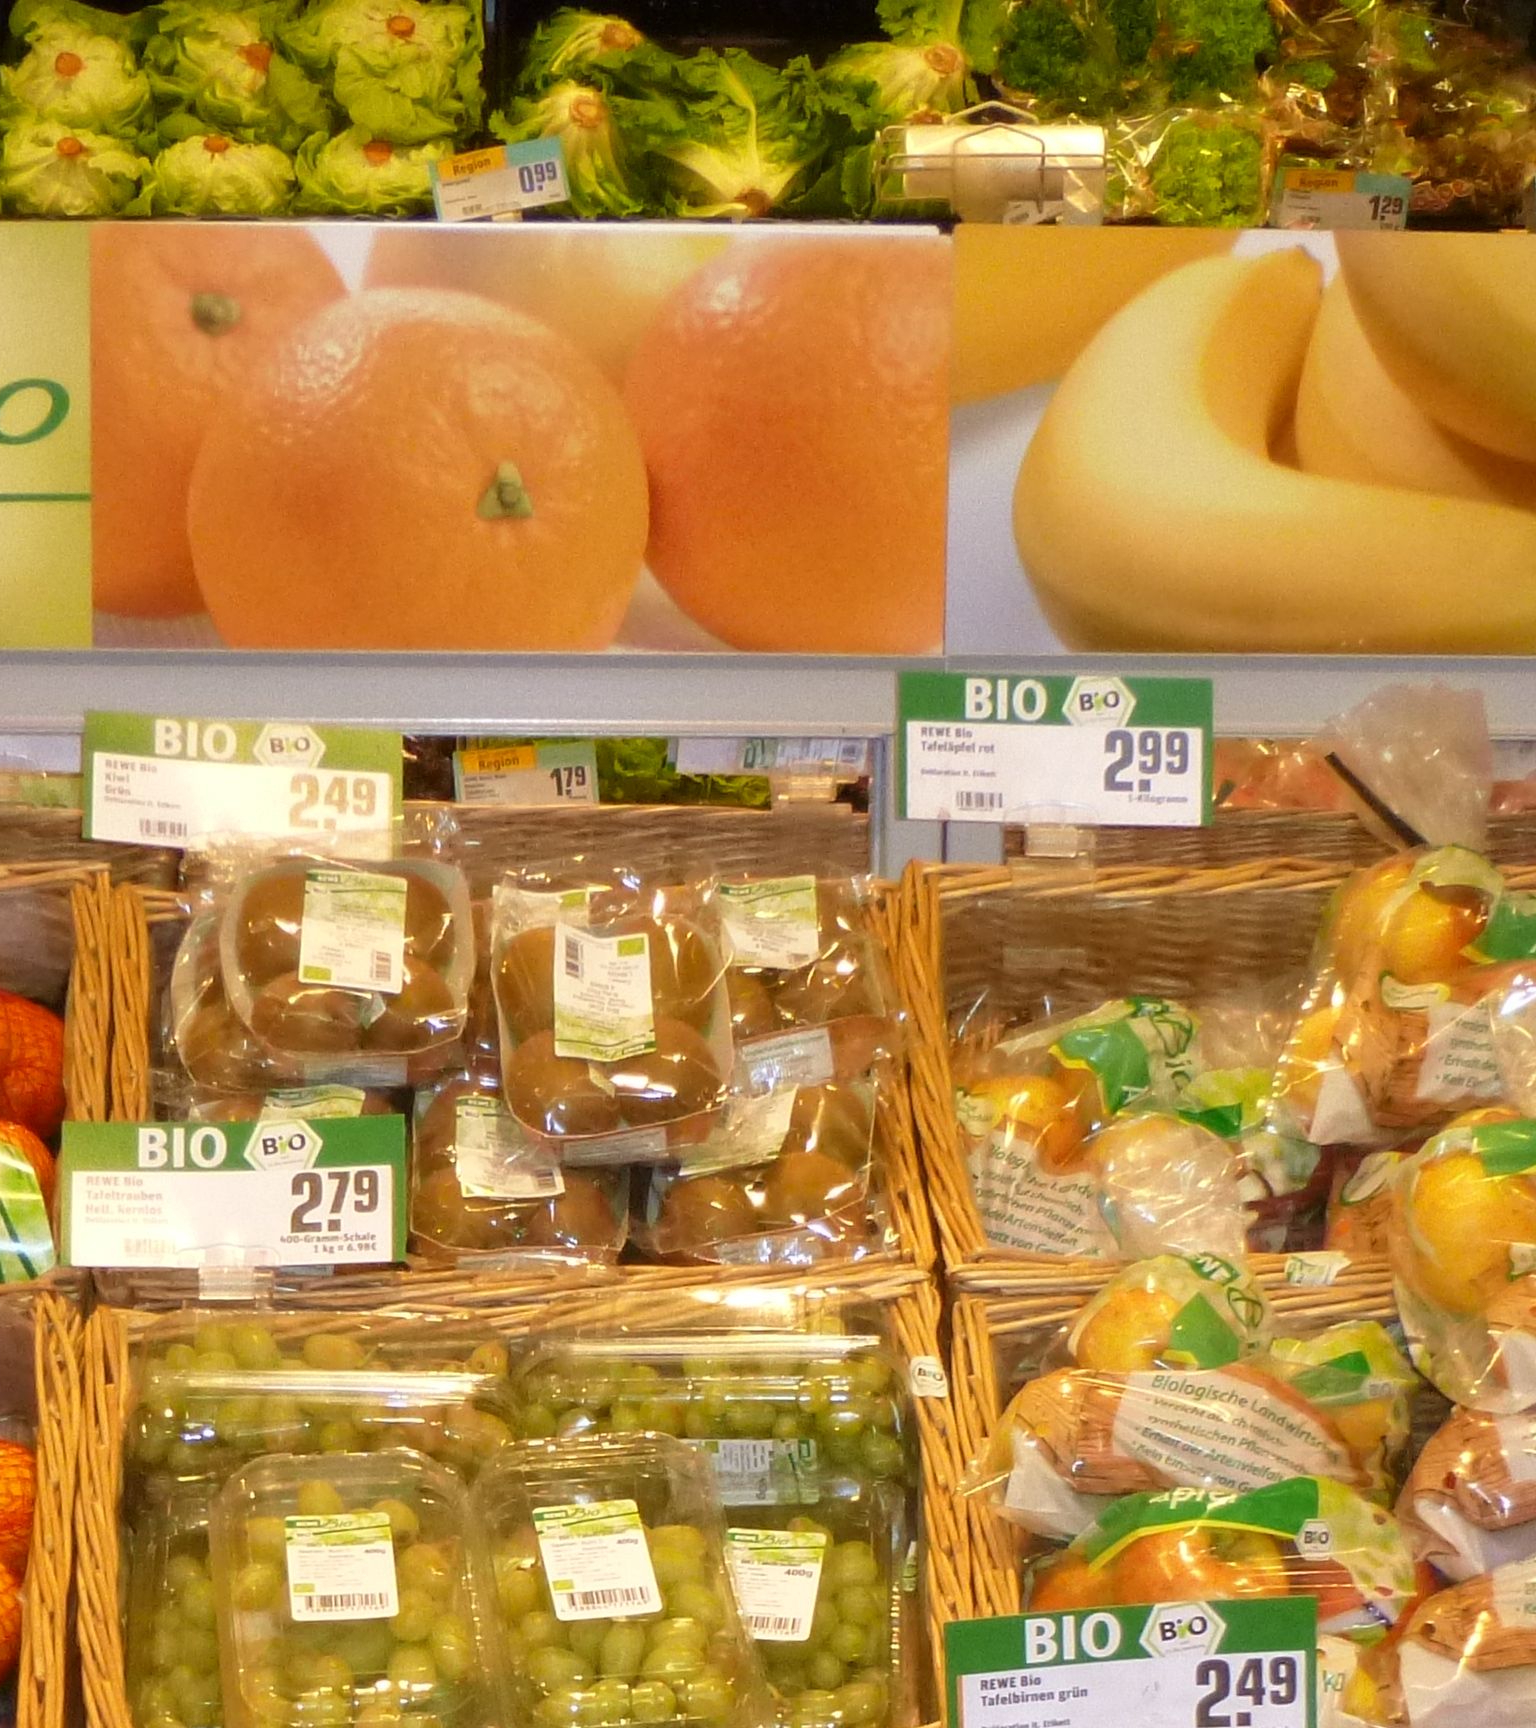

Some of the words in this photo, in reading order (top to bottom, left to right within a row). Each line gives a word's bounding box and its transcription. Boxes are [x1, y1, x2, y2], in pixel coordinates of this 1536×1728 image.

[453, 158, 491, 176] Region
[519, 161, 557, 193] 0.99
[1369, 194, 1403, 220] 1.29
[965, 678, 1047, 721] BIO
[154, 719, 237, 760] BIO
[921, 727, 951, 738] REWE
[955, 728, 972, 738] Bio
[921, 740, 976, 755] Tafeläpfel
[979, 743, 994, 753] rot
[478, 755, 520, 771] Region
[1104, 730, 1189, 792] 2.99
[550, 766, 586, 796] 1.79
[290, 773, 377, 830] 2.49
[137, 1127, 227, 1168] BIO
[290, 1170, 379, 1233] 2.79
[1024, 1612, 1121, 1664] BIO
[980, 1676, 1017, 1691] REWE
[1020, 1675, 1042, 1687] Bio
[980, 1690, 1055, 1707] Tafelbirnen
[1058, 1687, 1088, 1702] grün
[1196, 1657, 1297, 1728] 2.49
